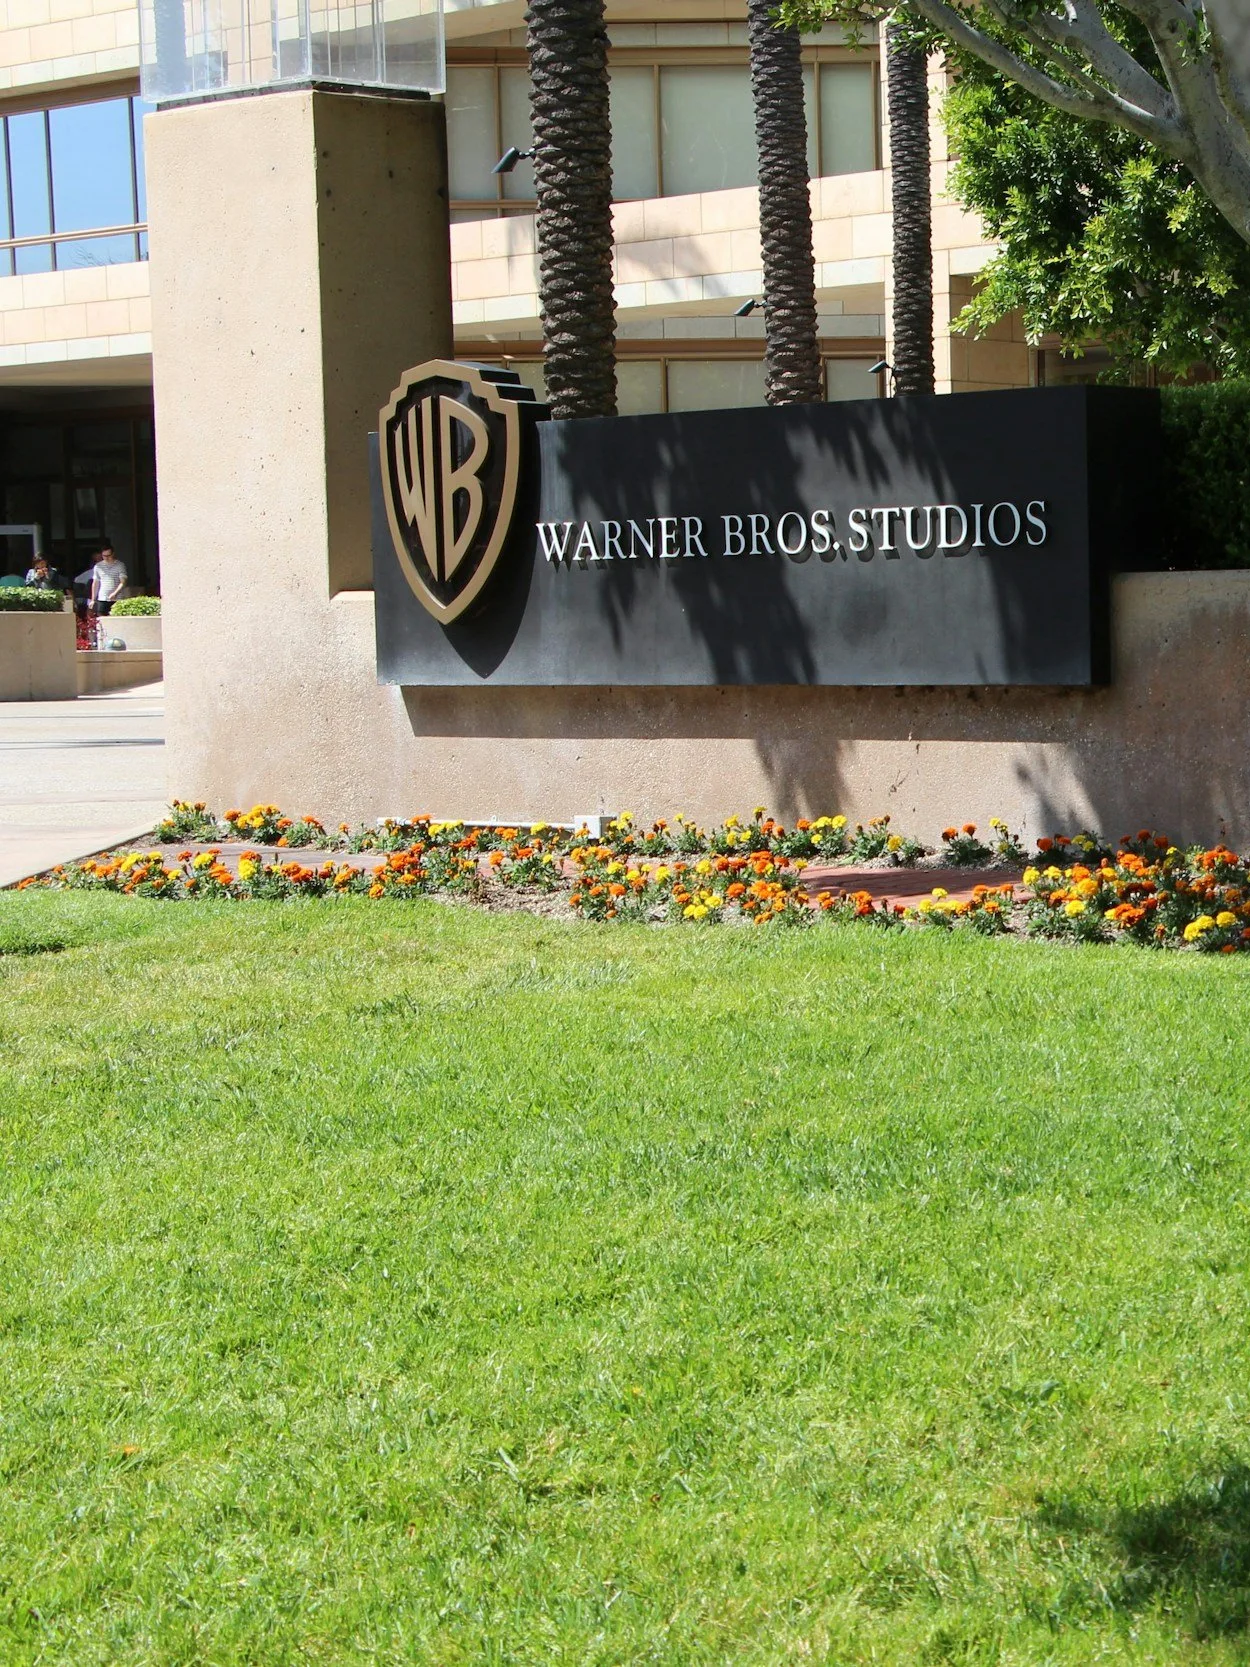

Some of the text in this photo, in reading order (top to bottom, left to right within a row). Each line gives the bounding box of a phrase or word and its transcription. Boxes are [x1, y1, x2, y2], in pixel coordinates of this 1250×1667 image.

[394, 394, 490, 582] WB
[535, 500, 1048, 563] WARNER BROS. STUDIOS
